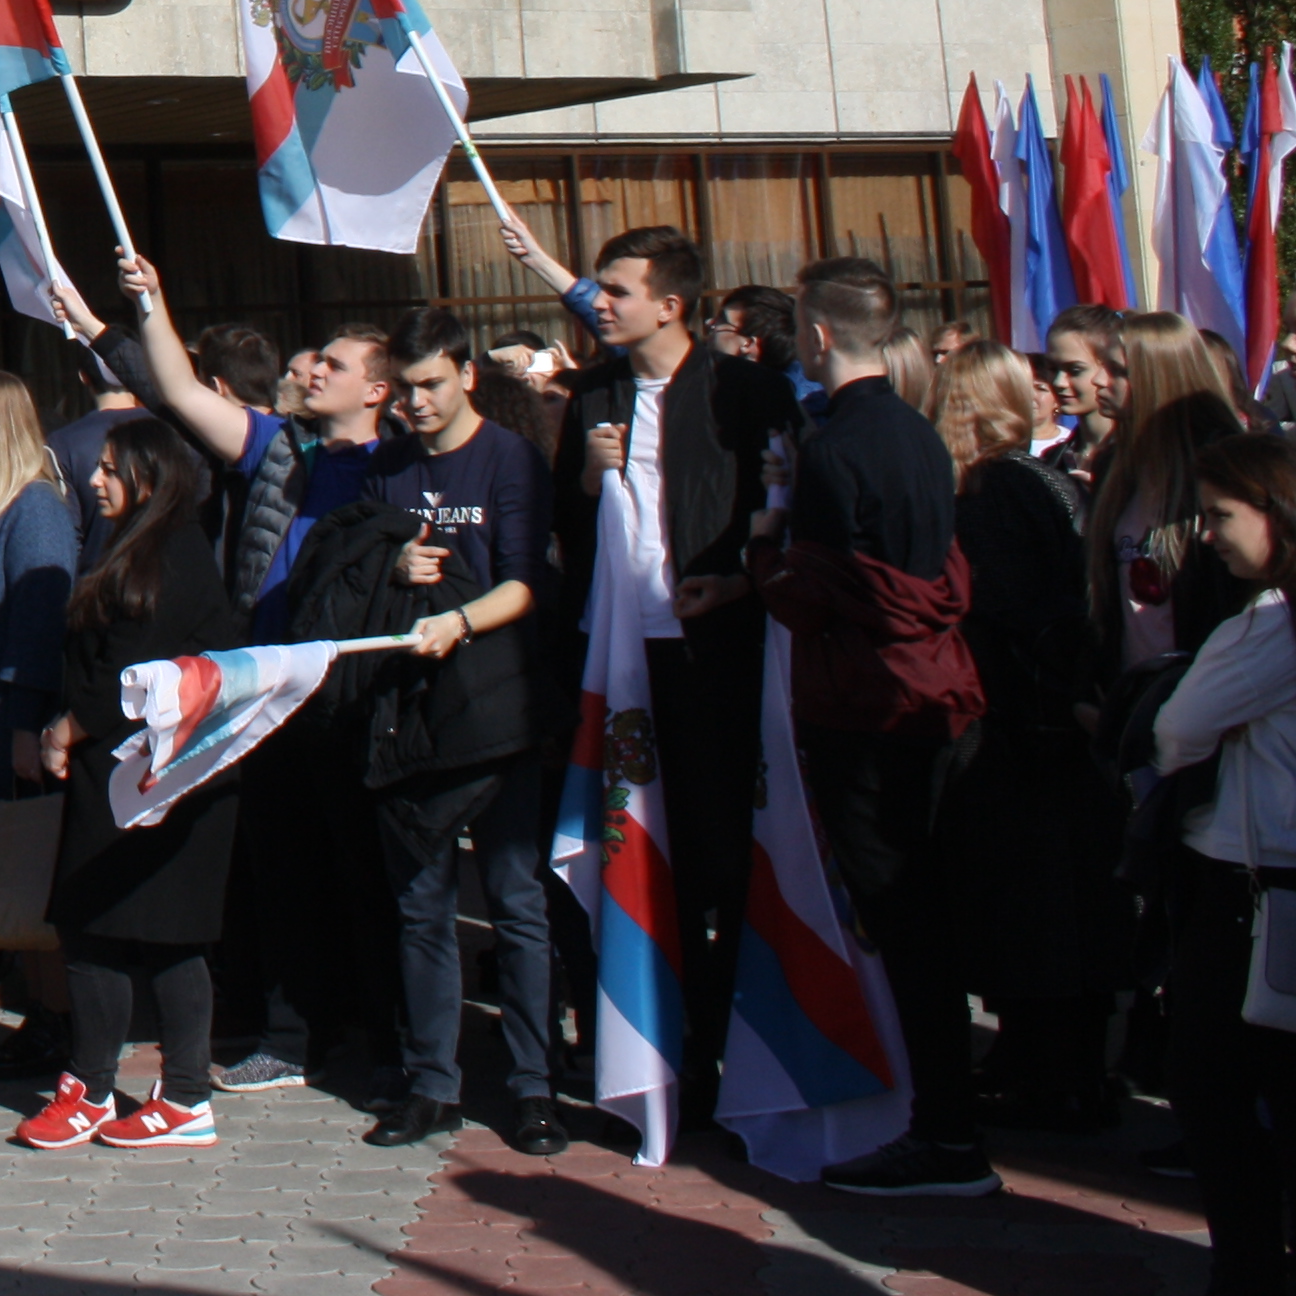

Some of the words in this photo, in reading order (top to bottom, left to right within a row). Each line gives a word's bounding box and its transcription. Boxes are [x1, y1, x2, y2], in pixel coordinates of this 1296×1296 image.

[435, 506, 483, 525] JEANS
[68, 1111, 92, 1133] N
[140, 1111, 169, 1133] N
